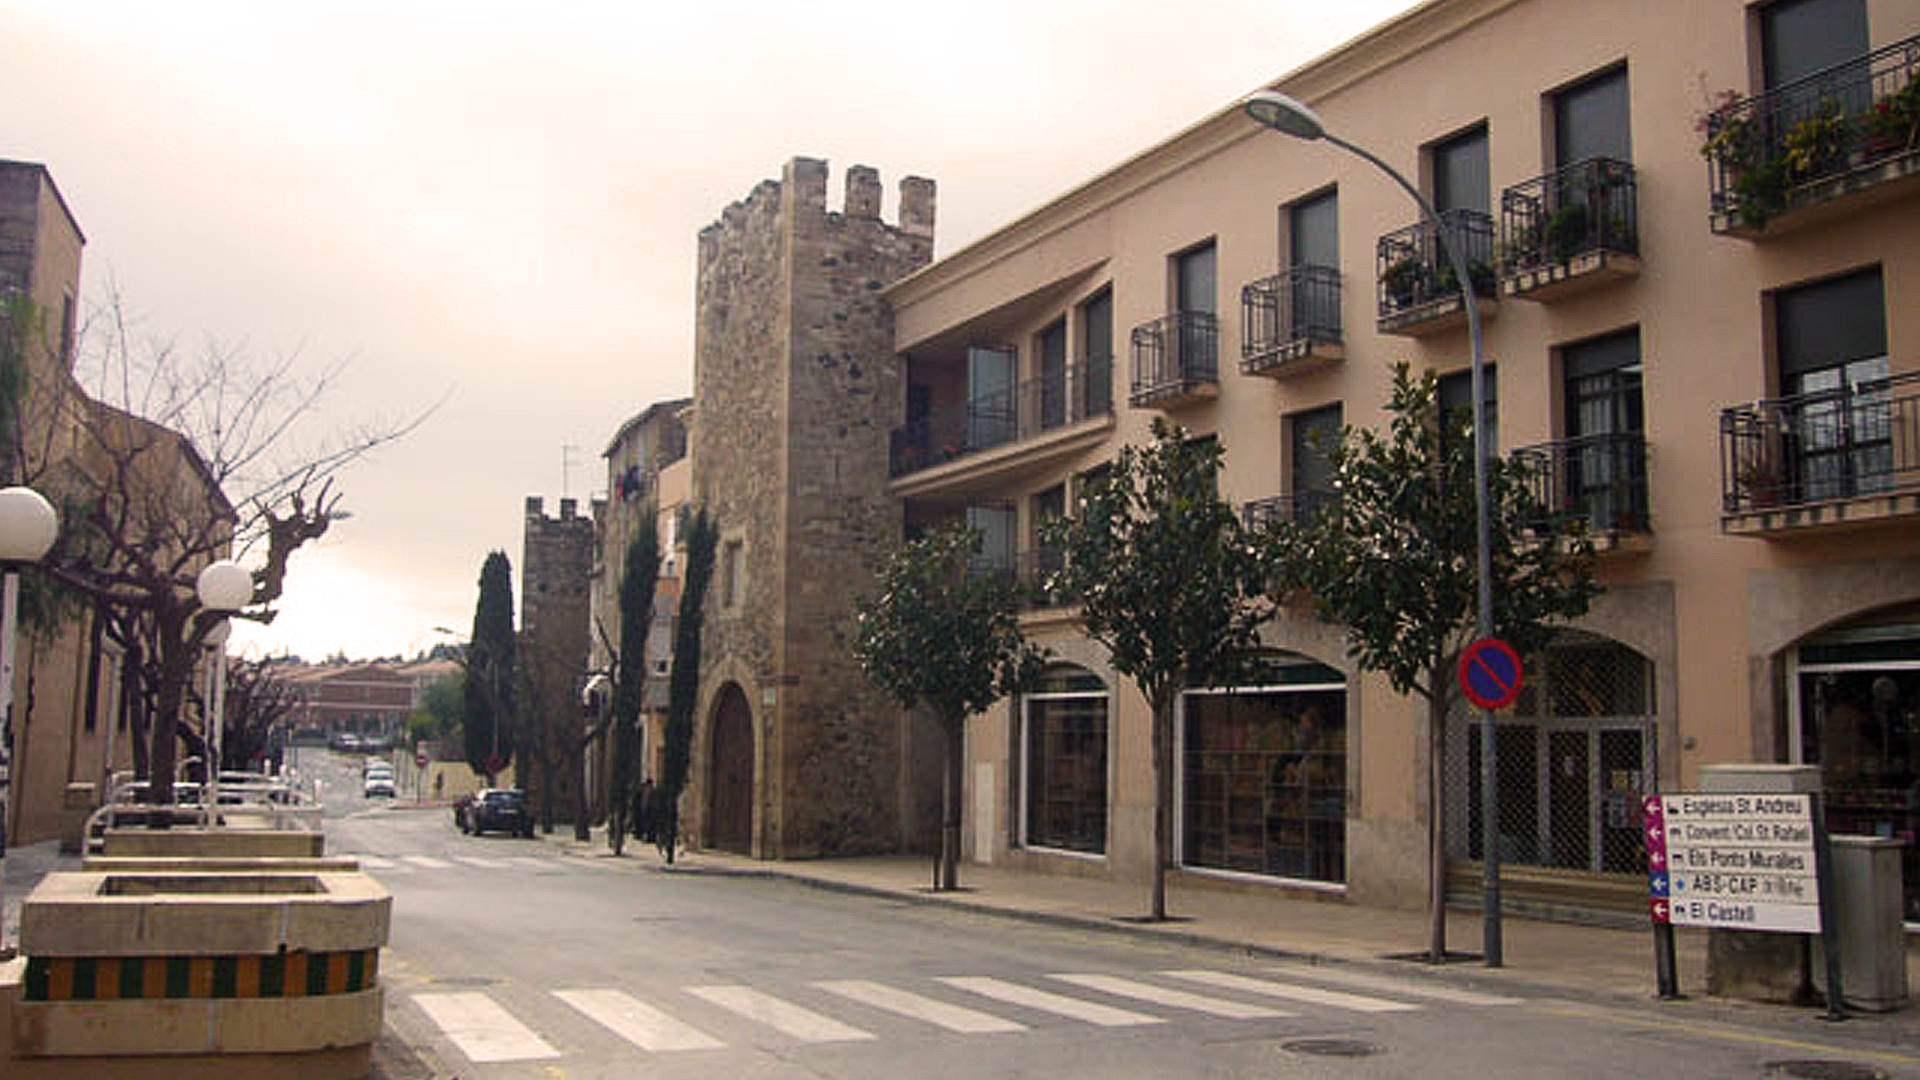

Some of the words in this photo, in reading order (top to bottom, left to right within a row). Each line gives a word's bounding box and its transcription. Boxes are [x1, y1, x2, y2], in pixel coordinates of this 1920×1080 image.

[1756, 797, 1803, 814] Andreu
[1691, 902, 1705, 919] El
[1708, 902, 1756, 922] Castell
